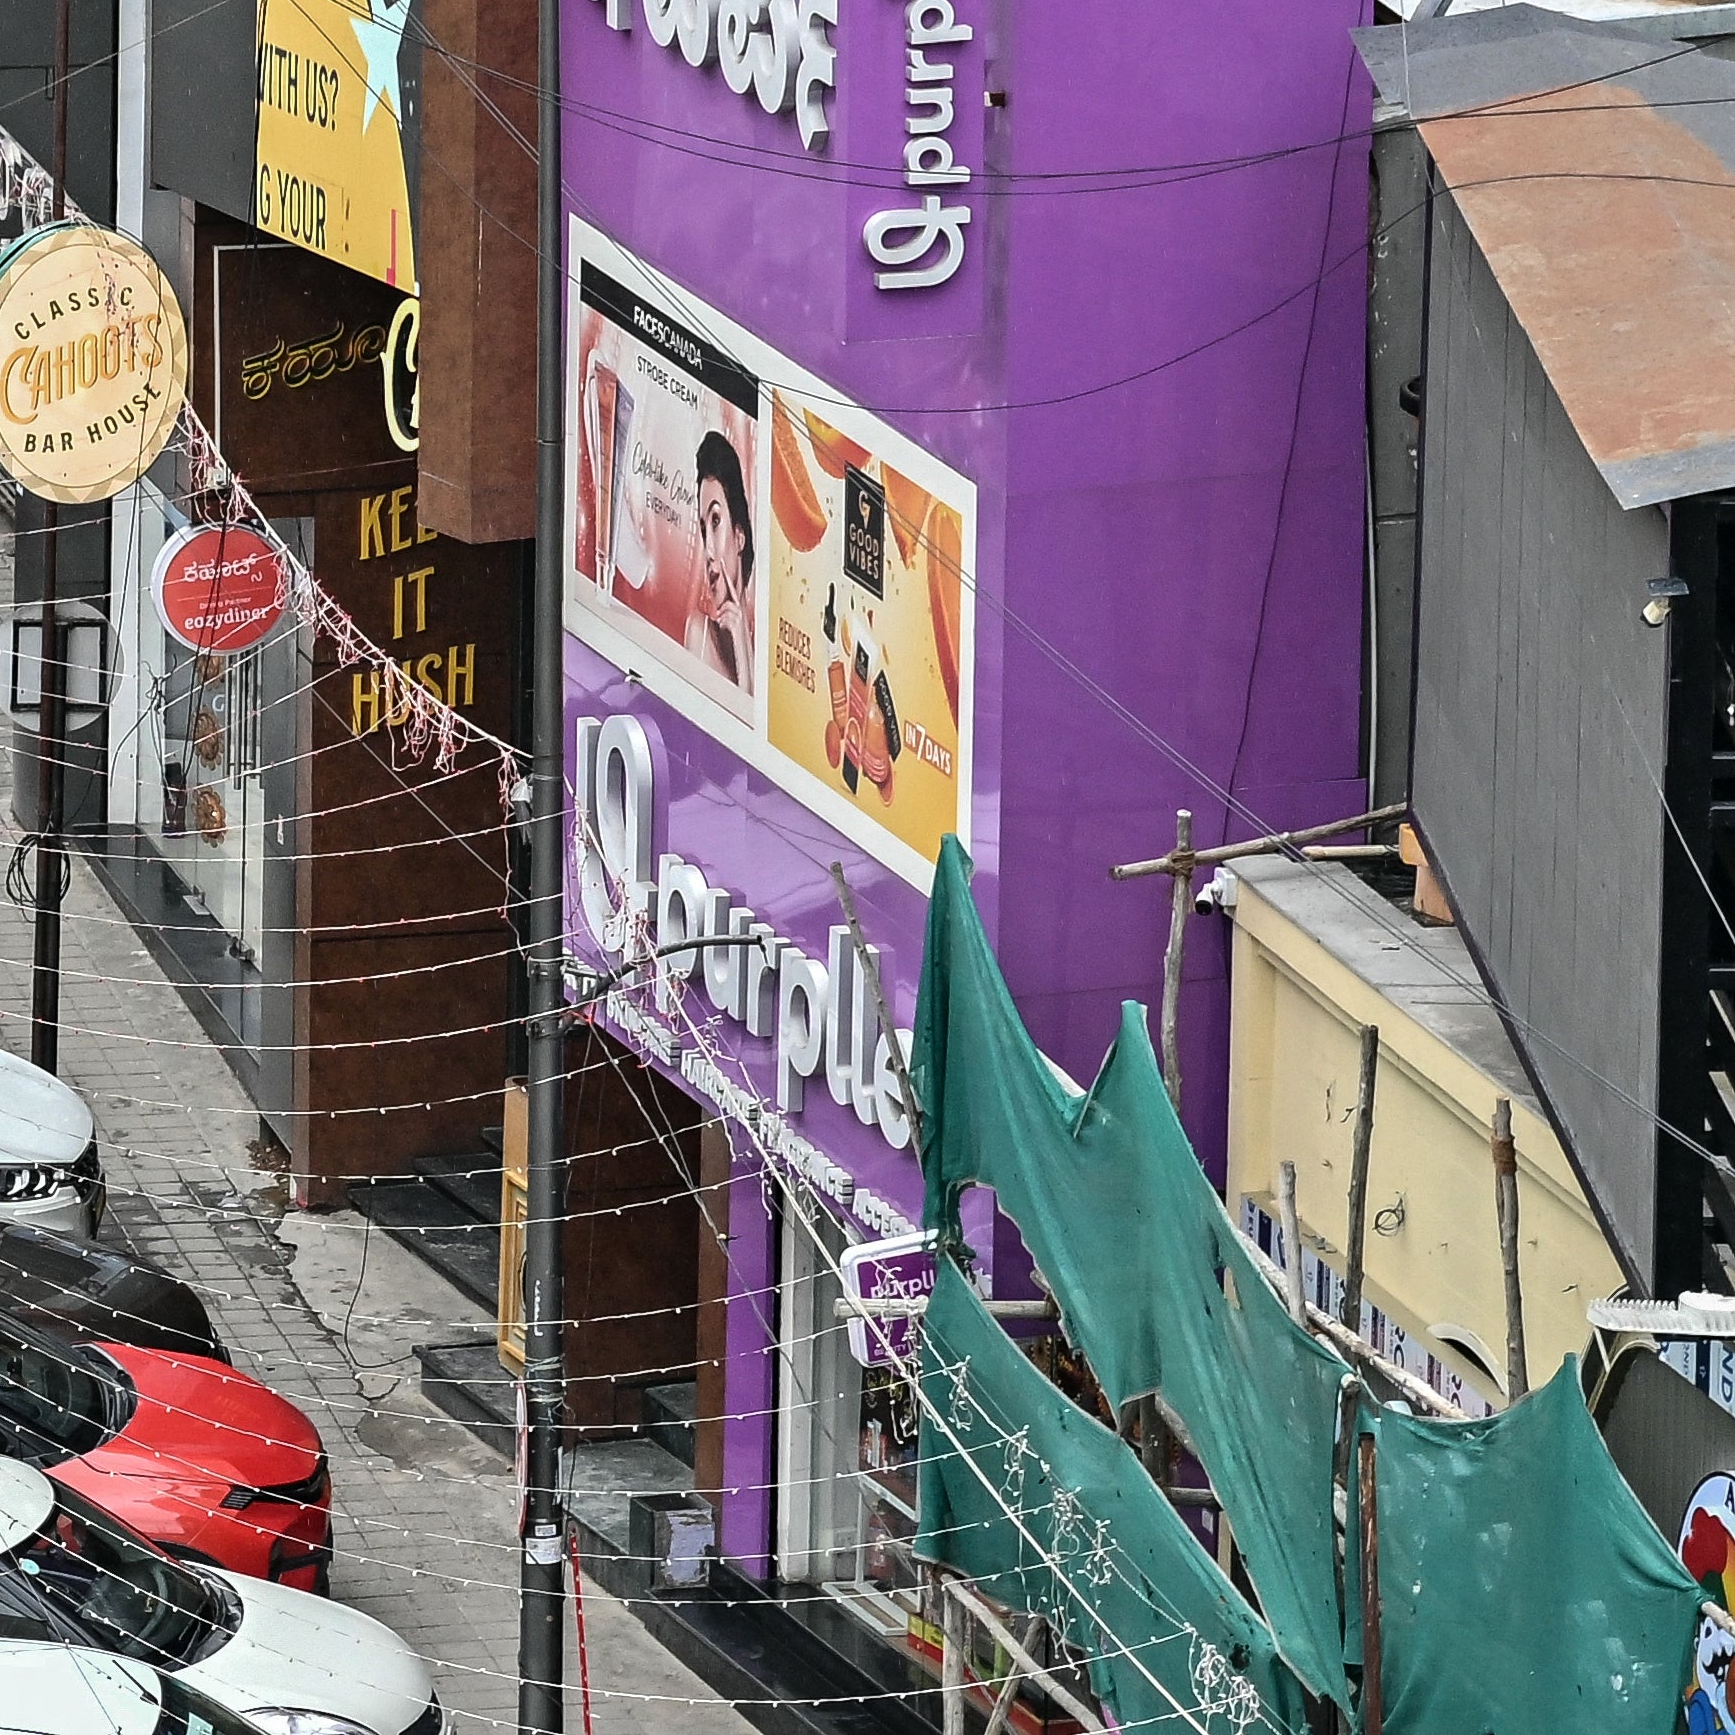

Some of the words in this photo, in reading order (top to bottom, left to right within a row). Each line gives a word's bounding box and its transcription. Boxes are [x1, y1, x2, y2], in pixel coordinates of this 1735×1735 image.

[305, 59, 339, 131] US?
[277, 169, 327, 250] YOUR
[636, 355, 669, 391] STROBE
[669, 377, 699, 411] CREAM
[24, 431, 74, 453] BAR
[86, 383, 161, 444] HOUSE
[848, 522, 880, 558] GOOD
[848, 545, 880, 581] VIBES
[392, 568, 435, 640] IT
[778, 616, 812, 662] REDUCES
[351, 643, 476, 736] HUSH
[775, 644, 817, 695] BLEMISHES
[904, 720, 917, 748] IN
[916, 721, 927, 763] 7
[926, 738, 952, 777] DAYS
[657, 853, 915, 1150] purplle
[869, 1269, 935, 1300] purpll
